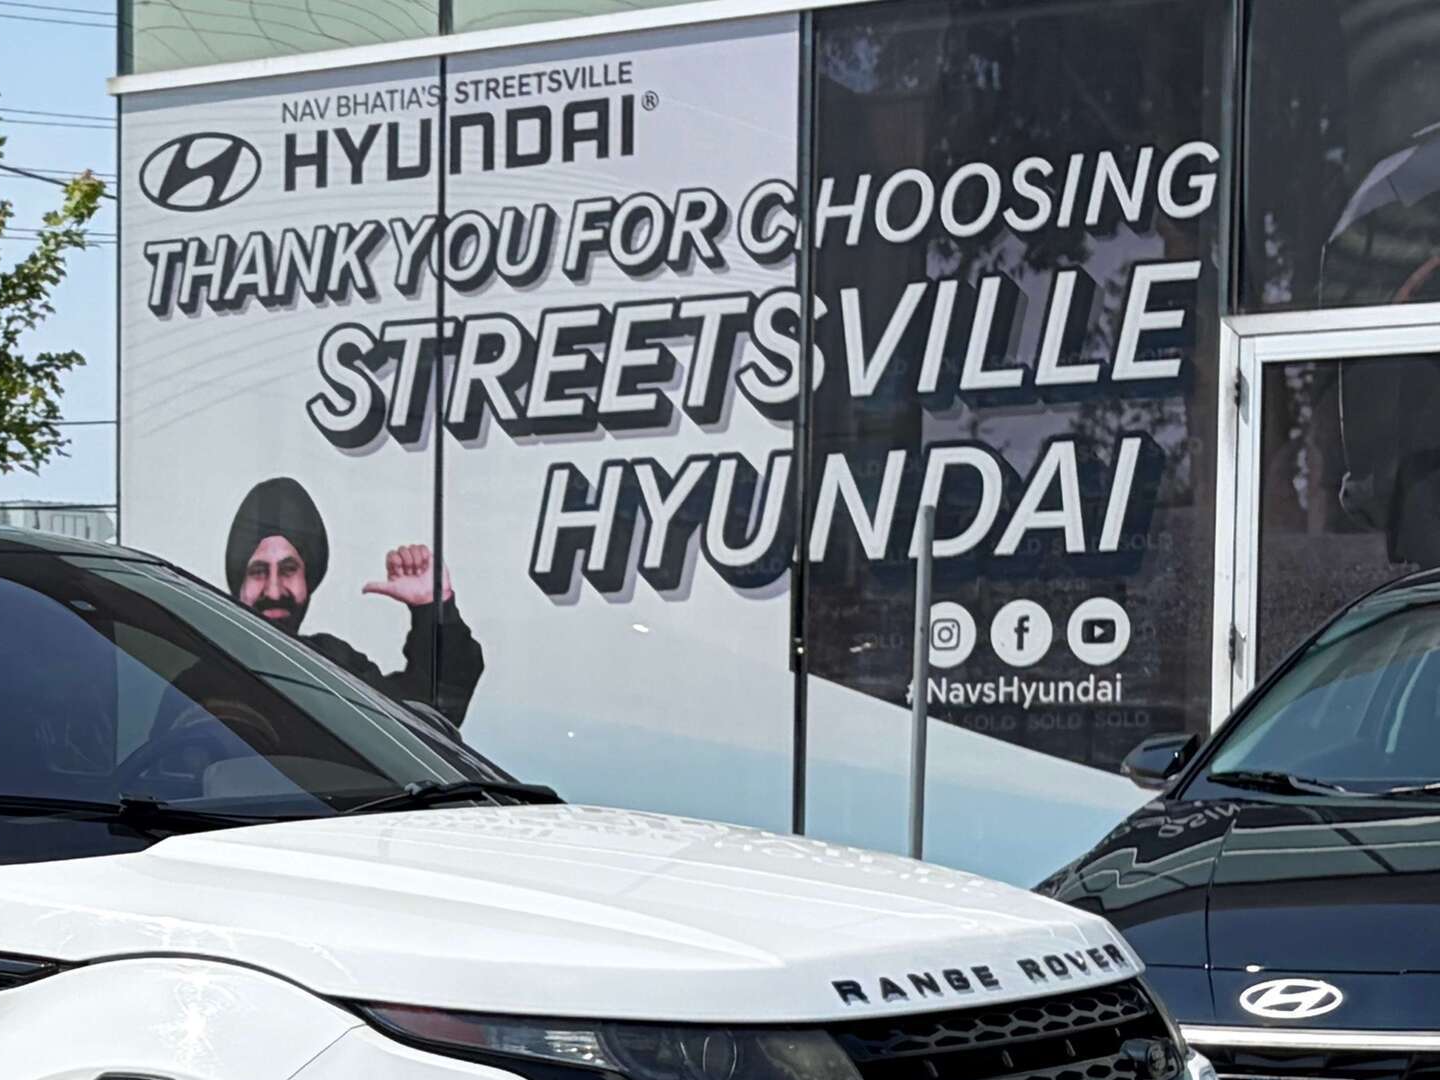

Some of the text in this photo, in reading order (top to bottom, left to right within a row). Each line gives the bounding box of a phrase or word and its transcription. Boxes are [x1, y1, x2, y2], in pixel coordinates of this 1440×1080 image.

[281, 60, 633, 124] NAV BHATIA'S STREETSVILLE
[144, 140, 1220, 320] THANK YOU FOR CHOOSING
[305, 260, 1204, 452] STREETSVILLE
[528, 433, 1150, 594] HYUNDAI
[831, 943, 1130, 1005] RANGE ROVER
